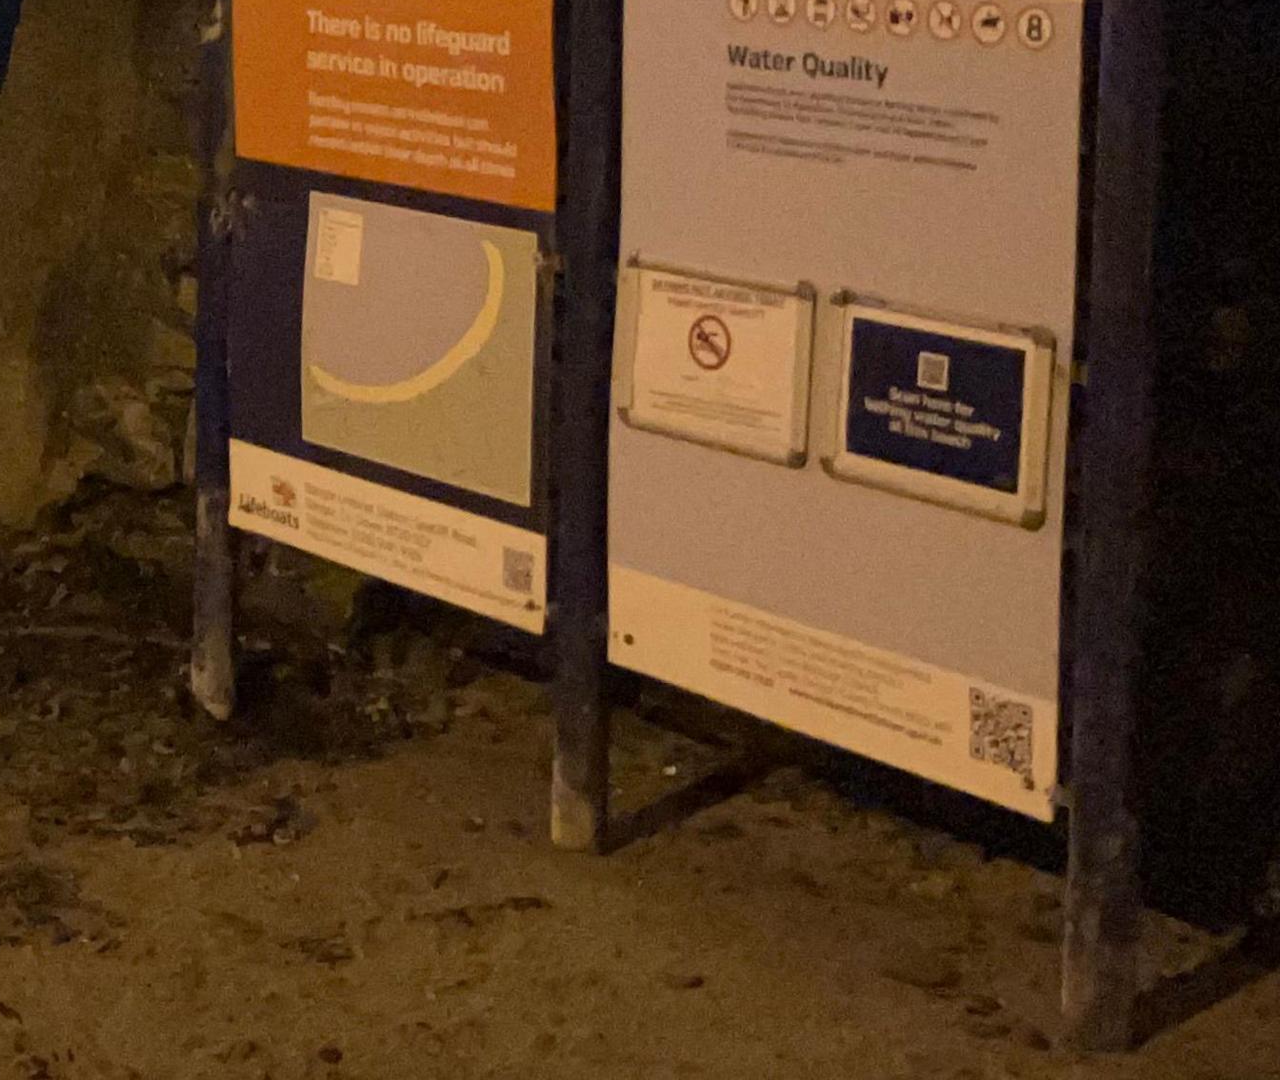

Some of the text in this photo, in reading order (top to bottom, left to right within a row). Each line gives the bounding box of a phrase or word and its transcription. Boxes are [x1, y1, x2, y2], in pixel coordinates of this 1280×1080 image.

[306, 9, 511, 56] There is no lifeguard
[306, 50, 505, 94] service in operation
[726, 43, 889, 89] Water Quality
[237, 492, 301, 530] Lifeboats
